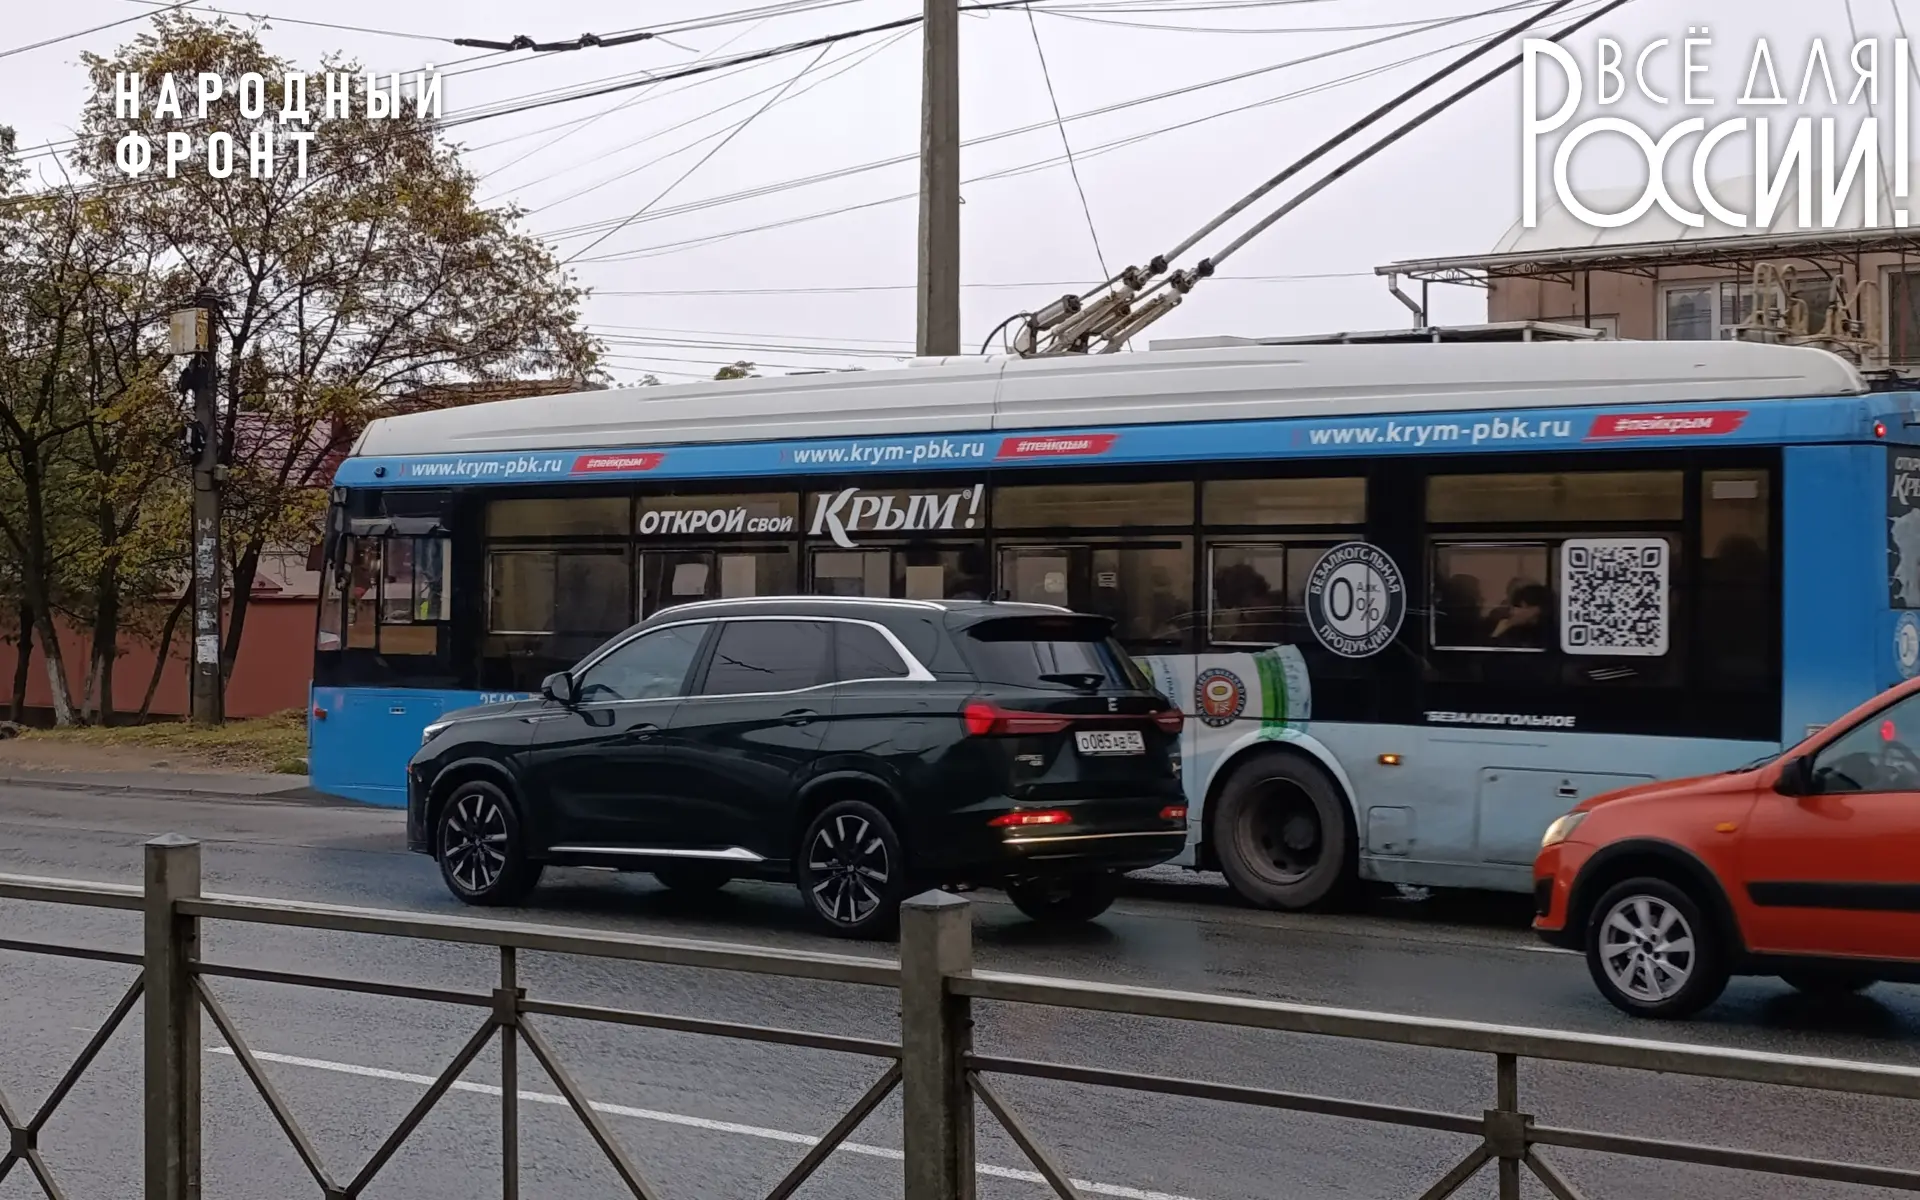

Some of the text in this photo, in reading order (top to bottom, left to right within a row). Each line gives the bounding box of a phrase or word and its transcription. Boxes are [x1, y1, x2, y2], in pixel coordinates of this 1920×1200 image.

[1309, 417, 1571, 447] www.krym-pbk.ru
[793, 440, 985, 465] www.krym-pbk.ru
[411, 456, 562, 481] www.krym-pbk.ru
[639, 506, 747, 534] ОТКРОЙ
[1319, 624, 1392, 654] ПРОДУКЦИЯ
